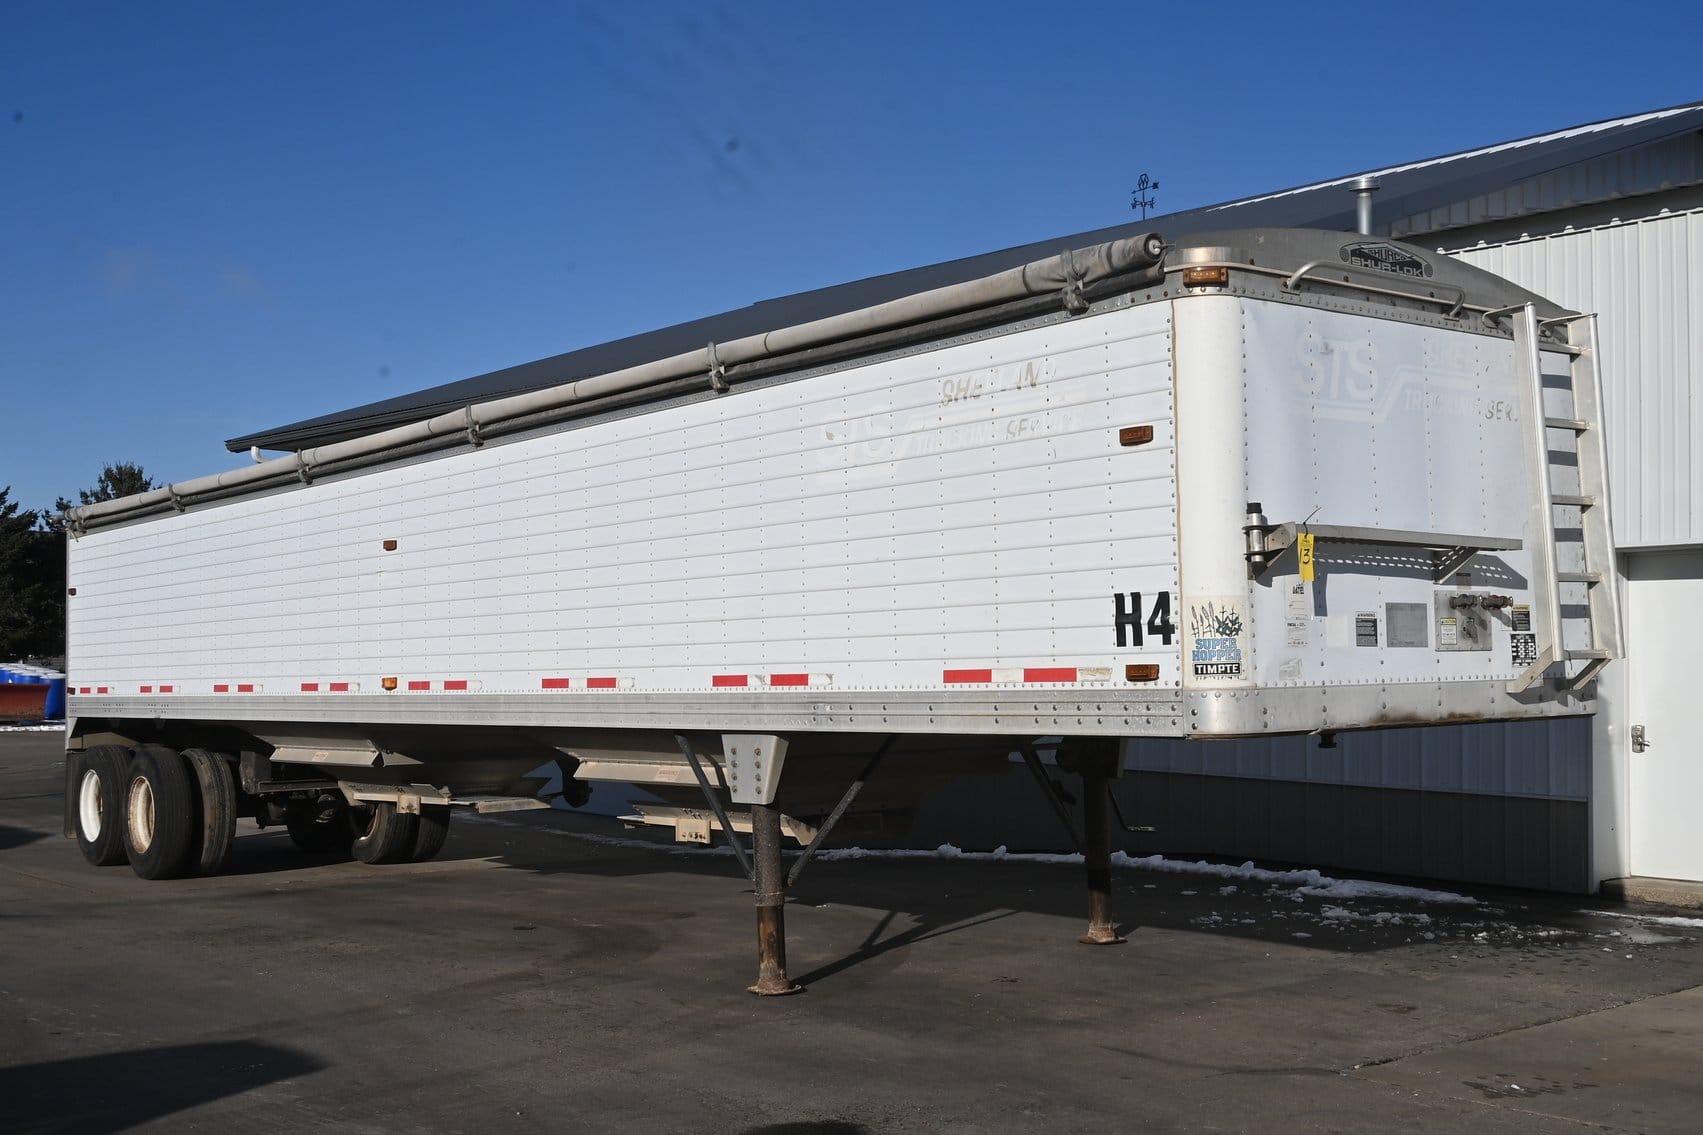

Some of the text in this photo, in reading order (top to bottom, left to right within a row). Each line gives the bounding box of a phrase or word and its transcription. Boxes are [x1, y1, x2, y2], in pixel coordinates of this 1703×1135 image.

[1351, 256, 1423, 277] SHUR-LOK
[1114, 591, 1175, 647] H4
[1195, 638, 1238, 649] SUPER
[1192, 649, 1241, 661] HOPPER
[1195, 664, 1239, 674] TIMPTE
